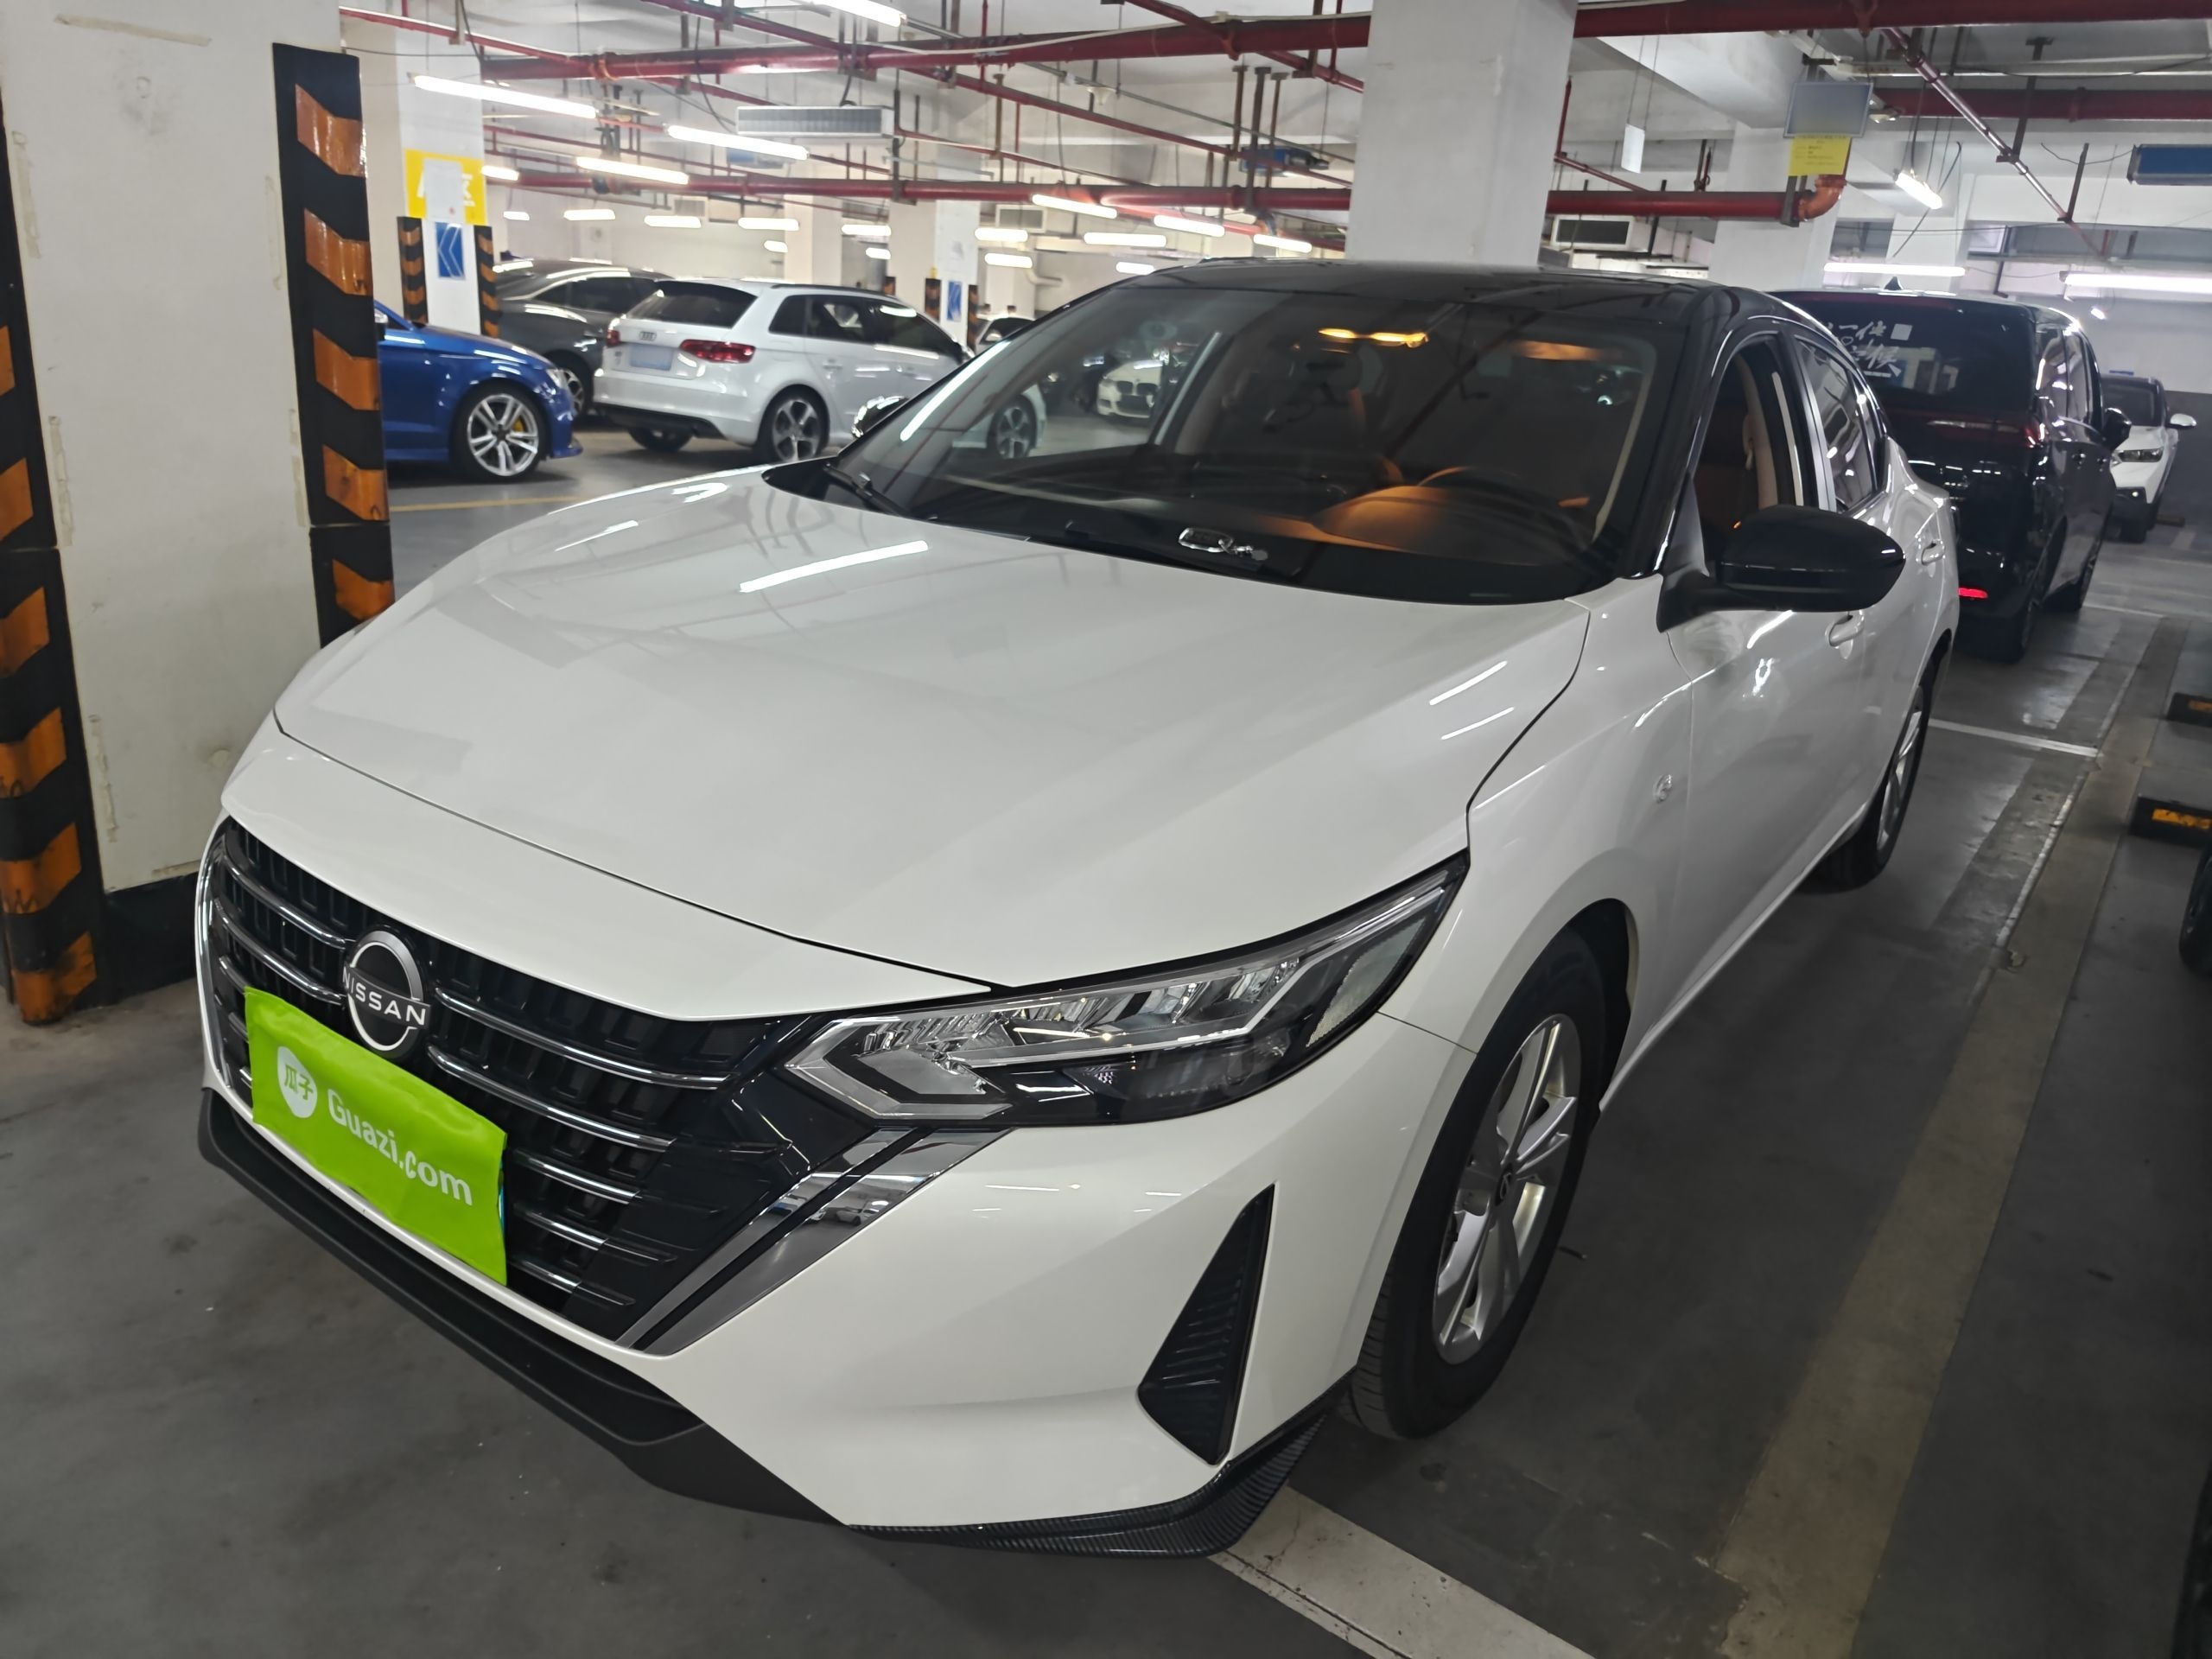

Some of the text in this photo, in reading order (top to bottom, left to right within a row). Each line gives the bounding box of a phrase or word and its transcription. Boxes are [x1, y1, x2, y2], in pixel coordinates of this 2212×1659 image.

[342, 965, 427, 1027] NISSAN
[283, 1063, 314, 1102] 瓜子
[327, 1088, 474, 1206] Guazi.com
